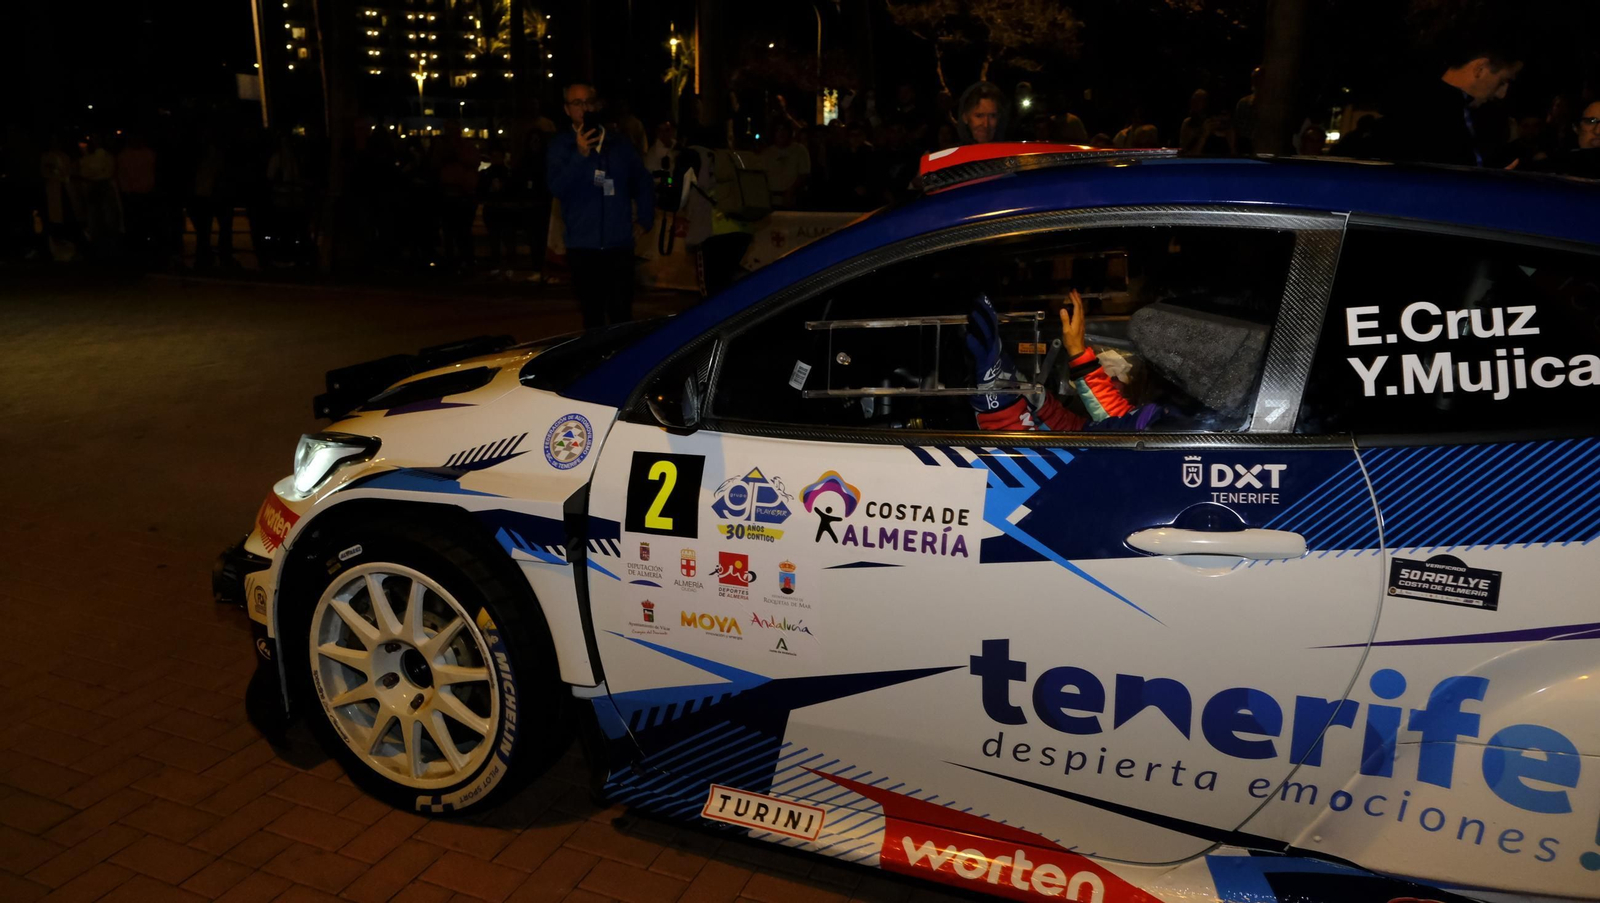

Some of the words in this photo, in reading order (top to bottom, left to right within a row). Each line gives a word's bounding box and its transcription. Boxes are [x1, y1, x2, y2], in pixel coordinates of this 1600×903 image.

[1346, 301, 1540, 346] E.Cruz
[1347, 347, 1600, 401] Y.Mujica
[1210, 463, 1287, 489] DXT
[645, 460, 678, 530] 2
[1210, 492, 1280, 504] TENERIFE
[262, 503, 292, 539] worten
[865, 501, 936, 524] COSTA
[941, 507, 970, 526] DE
[726, 524, 745, 540] 30
[747, 524, 764, 533] AÑOS
[747, 532, 775, 543] CONTIGO
[842, 526, 969, 558] ALMERÍA
[627, 562, 663, 573] DIPUTACIÓN
[637, 571, 663, 579] ALMERÍA
[1399, 568, 1421, 580] 50
[1421, 571, 1491, 590] RALLYE
[1425, 562, 1467, 573] VERIFICADO
[674, 579, 704, 589] ALMERÍA
[719, 586, 749, 596] DEPORTES
[1398, 580, 1429, 590] COSTA
[680, 610, 742, 635] MOYA
[751, 611, 814, 637] Andalucía
[494, 651, 517, 757] MICHELIN
[482, 764, 500, 790] PILOT
[459, 783, 484, 804] SPORT
[982, 731, 1218, 792] despierta
[1248, 778, 1560, 862] emociones
[719, 794, 814, 833] TURINI
[901, 836, 1105, 903] worten
